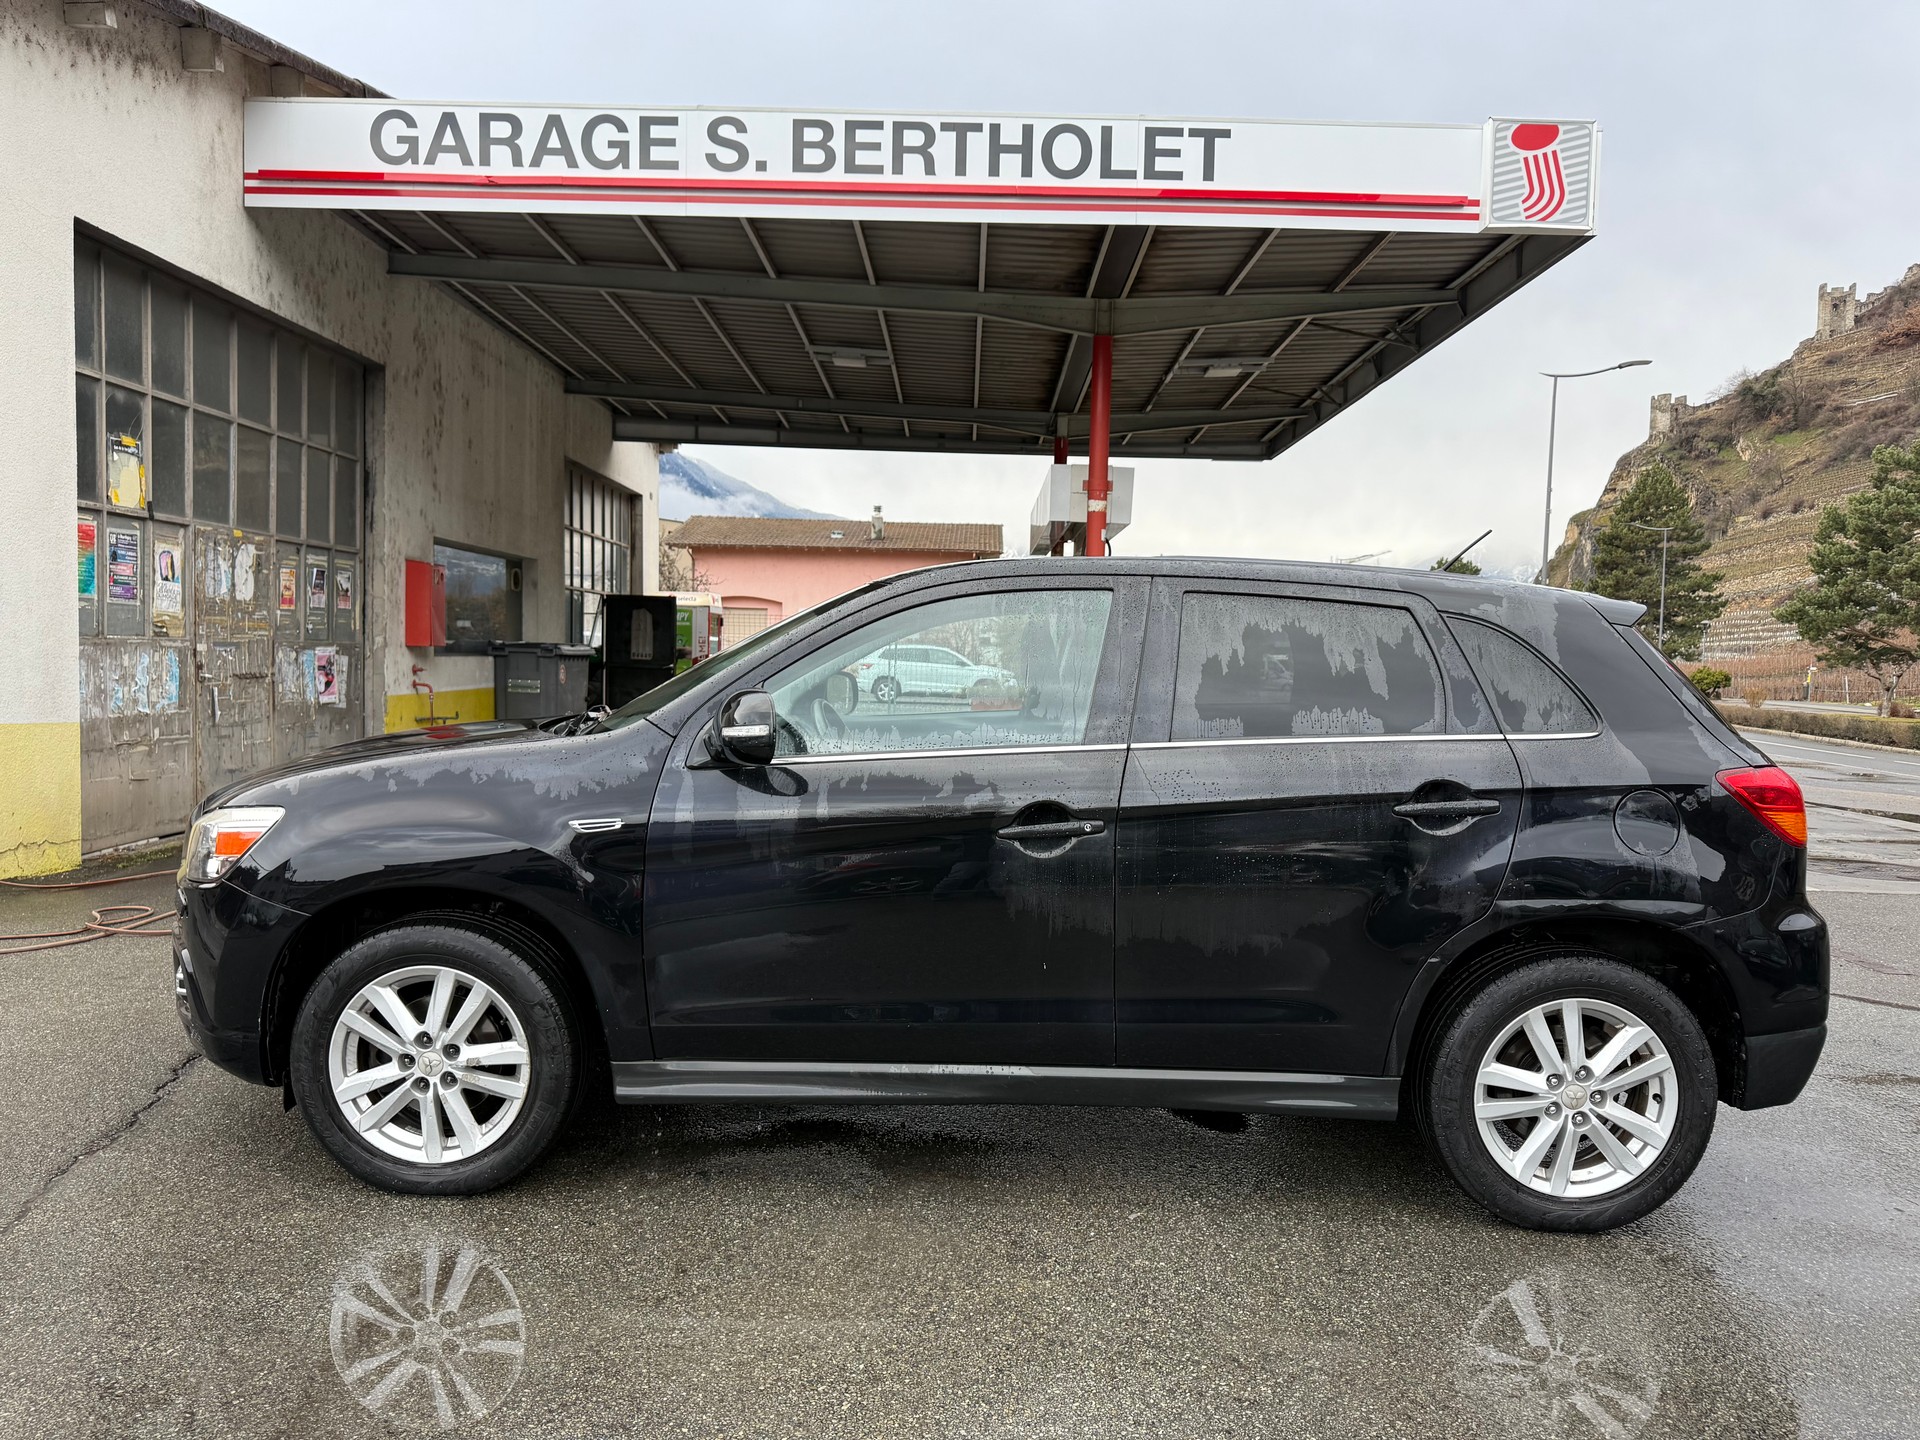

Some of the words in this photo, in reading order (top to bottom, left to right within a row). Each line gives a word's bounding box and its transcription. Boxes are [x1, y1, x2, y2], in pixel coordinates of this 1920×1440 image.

[369, 108, 680, 171] GARAGE
[703, 115, 768, 173] S.
[791, 119, 1232, 182] BERTHOLET
